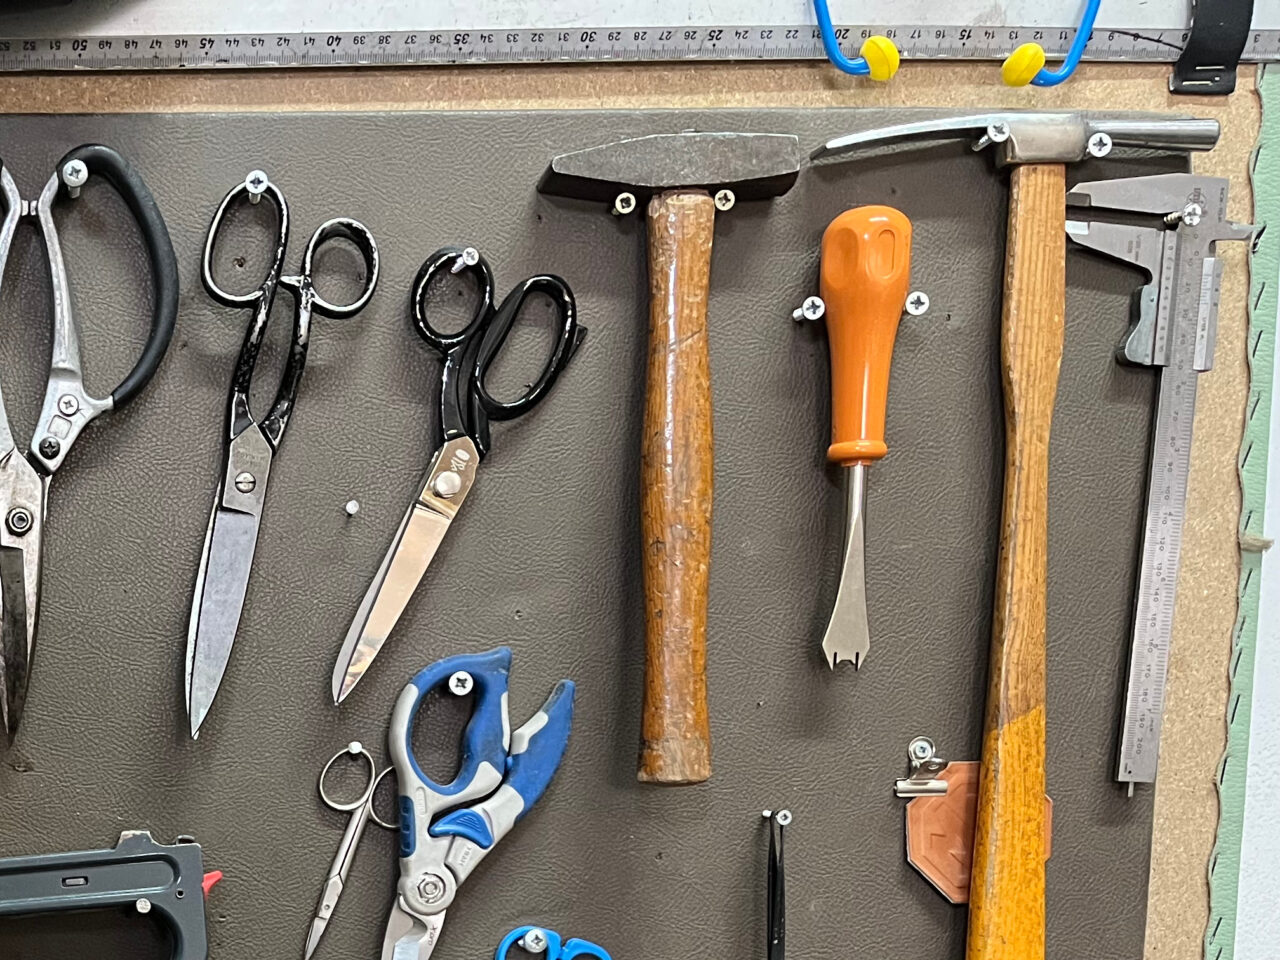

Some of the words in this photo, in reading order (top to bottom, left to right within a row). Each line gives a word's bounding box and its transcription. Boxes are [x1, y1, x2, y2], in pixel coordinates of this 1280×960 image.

[531, 33, 544, 42] 32
[558, 33, 569, 41] 31
[581, 32, 596, 42] 30
[608, 32, 621, 41] 29
[634, 32, 647, 40] 28
[659, 31, 672, 40] 27
[684, 31, 697, 40] 26
[708, 30, 723, 41] 25
[735, 30, 749, 39] 24
[761, 30, 773, 39] 23
[786, 30, 799, 39] 22
[835, 29, 850, 39] 20
[861, 30, 872, 39] 19
[886, 29, 896, 38] 18
[910, 30, 921, 39] 17
[959, 29, 972, 40] 15
[985, 30, 995, 39] 14
[1009, 31, 1018, 40] 13
[1033, 31, 1043, 40] 12
[1059, 31, 1067, 40] 11
[226, 38, 239, 47] 44
[251, 38, 264, 47] 43
[277, 37, 290, 46] 42
[304, 37, 315, 46] 41
[327, 35, 342, 46] 40
[353, 36, 365, 45] 39
[378, 35, 391, 44] 38
[405, 35, 417, 44] 37
[429, 35, 442, 44] 36
[454, 33, 469, 44] 35
[480, 34, 493, 43] 34
[507, 34, 519, 43] 33
[1254, 34, 1261, 43] 3
[23, 41, 36, 51] 52
[50, 39, 61, 50] 51
[72, 39, 88, 51] 50
[99, 40, 112, 49] 49
[125, 40, 138, 49] 48
[150, 39, 162, 48] 47
[175, 39, 188, 48] 46
[200, 38, 215, 49] 45
